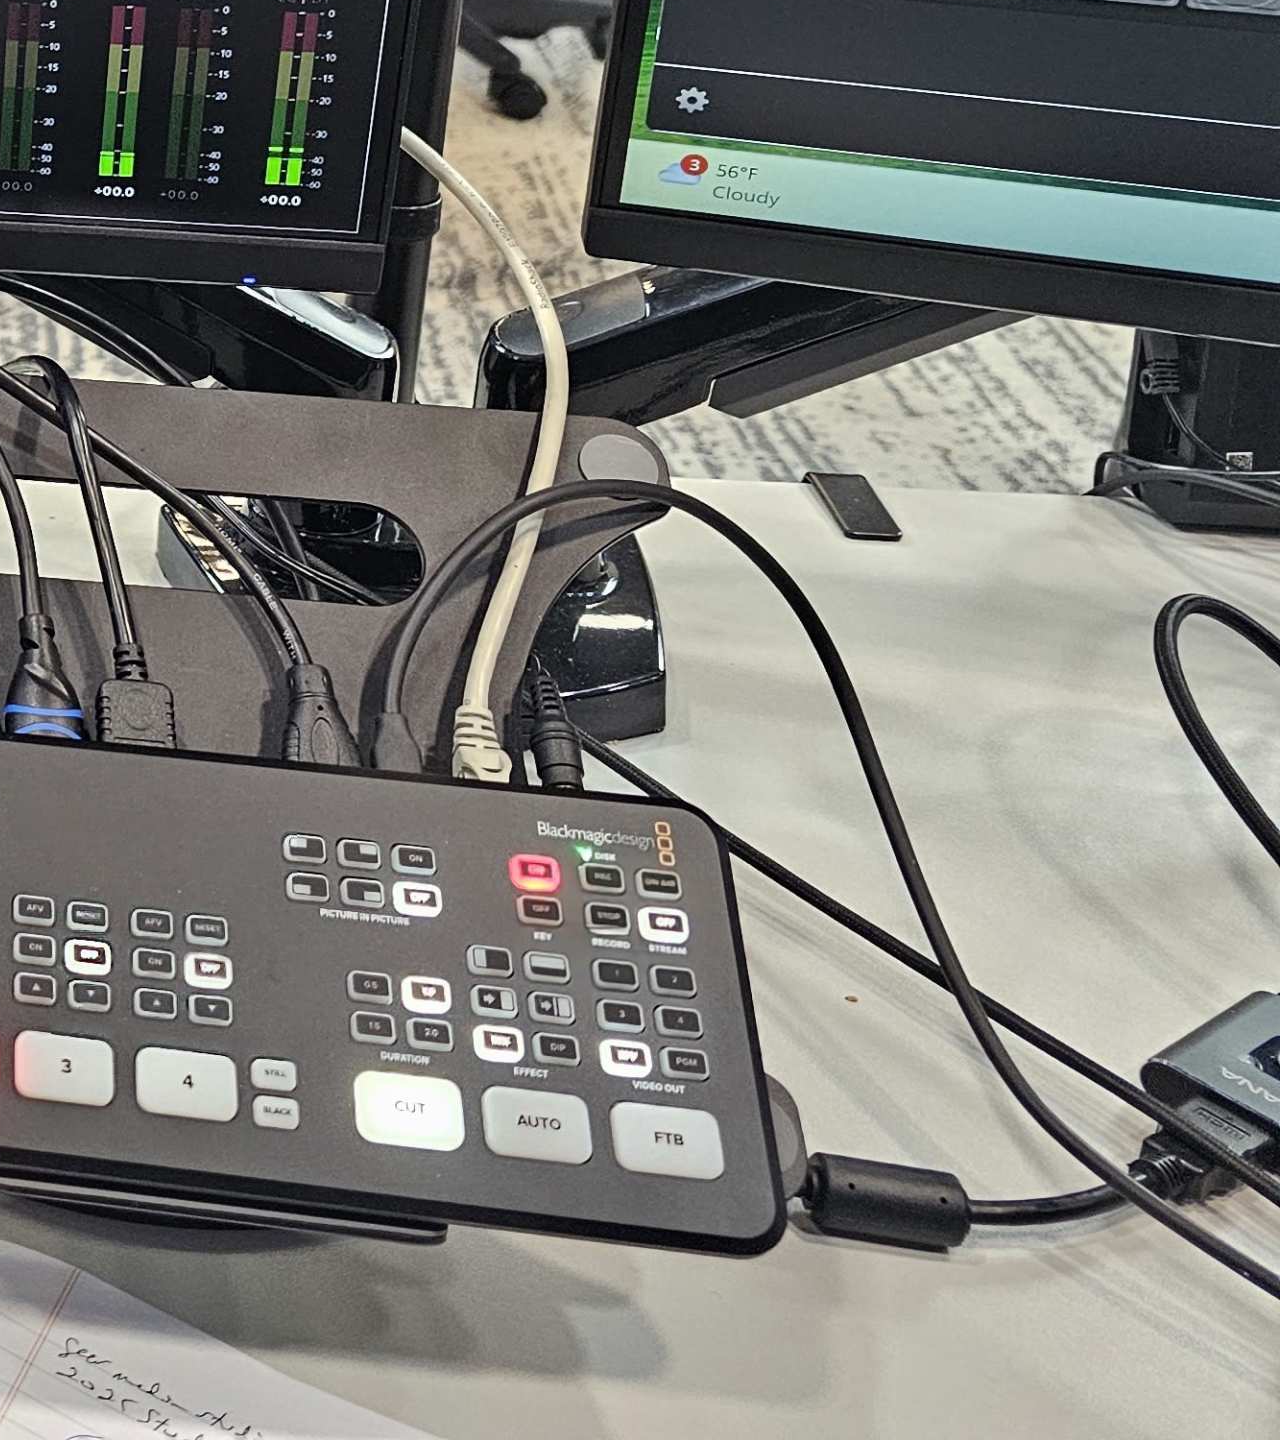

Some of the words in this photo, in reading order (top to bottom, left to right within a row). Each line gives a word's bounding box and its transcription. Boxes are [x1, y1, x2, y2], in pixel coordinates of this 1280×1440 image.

[689, 158, 699, 171] 3
[716, 163, 759, 181] 56°F
[712, 186, 780, 209] Cloudy
[409, 855, 423, 863] ON
[320, 908, 358, 920] PICTURE
[360, 913, 370, 922] IN
[371, 914, 410, 926] PICTURE
[534, 932, 552, 940] KEY
[380, 1051, 431, 1065] DURATION
[676, 1057, 697, 1066] PGM
[61, 1059, 71, 1073] 3
[514, 1066, 549, 1078] EFFECT
[182, 1074, 194, 1089] 4
[632, 1079, 662, 1092] VIDEO
[665, 1083, 685, 1094] OUT
[394, 1100, 425, 1115] CUT
[517, 1113, 561, 1131] AUTO
[653, 1131, 684, 1146] FTB
